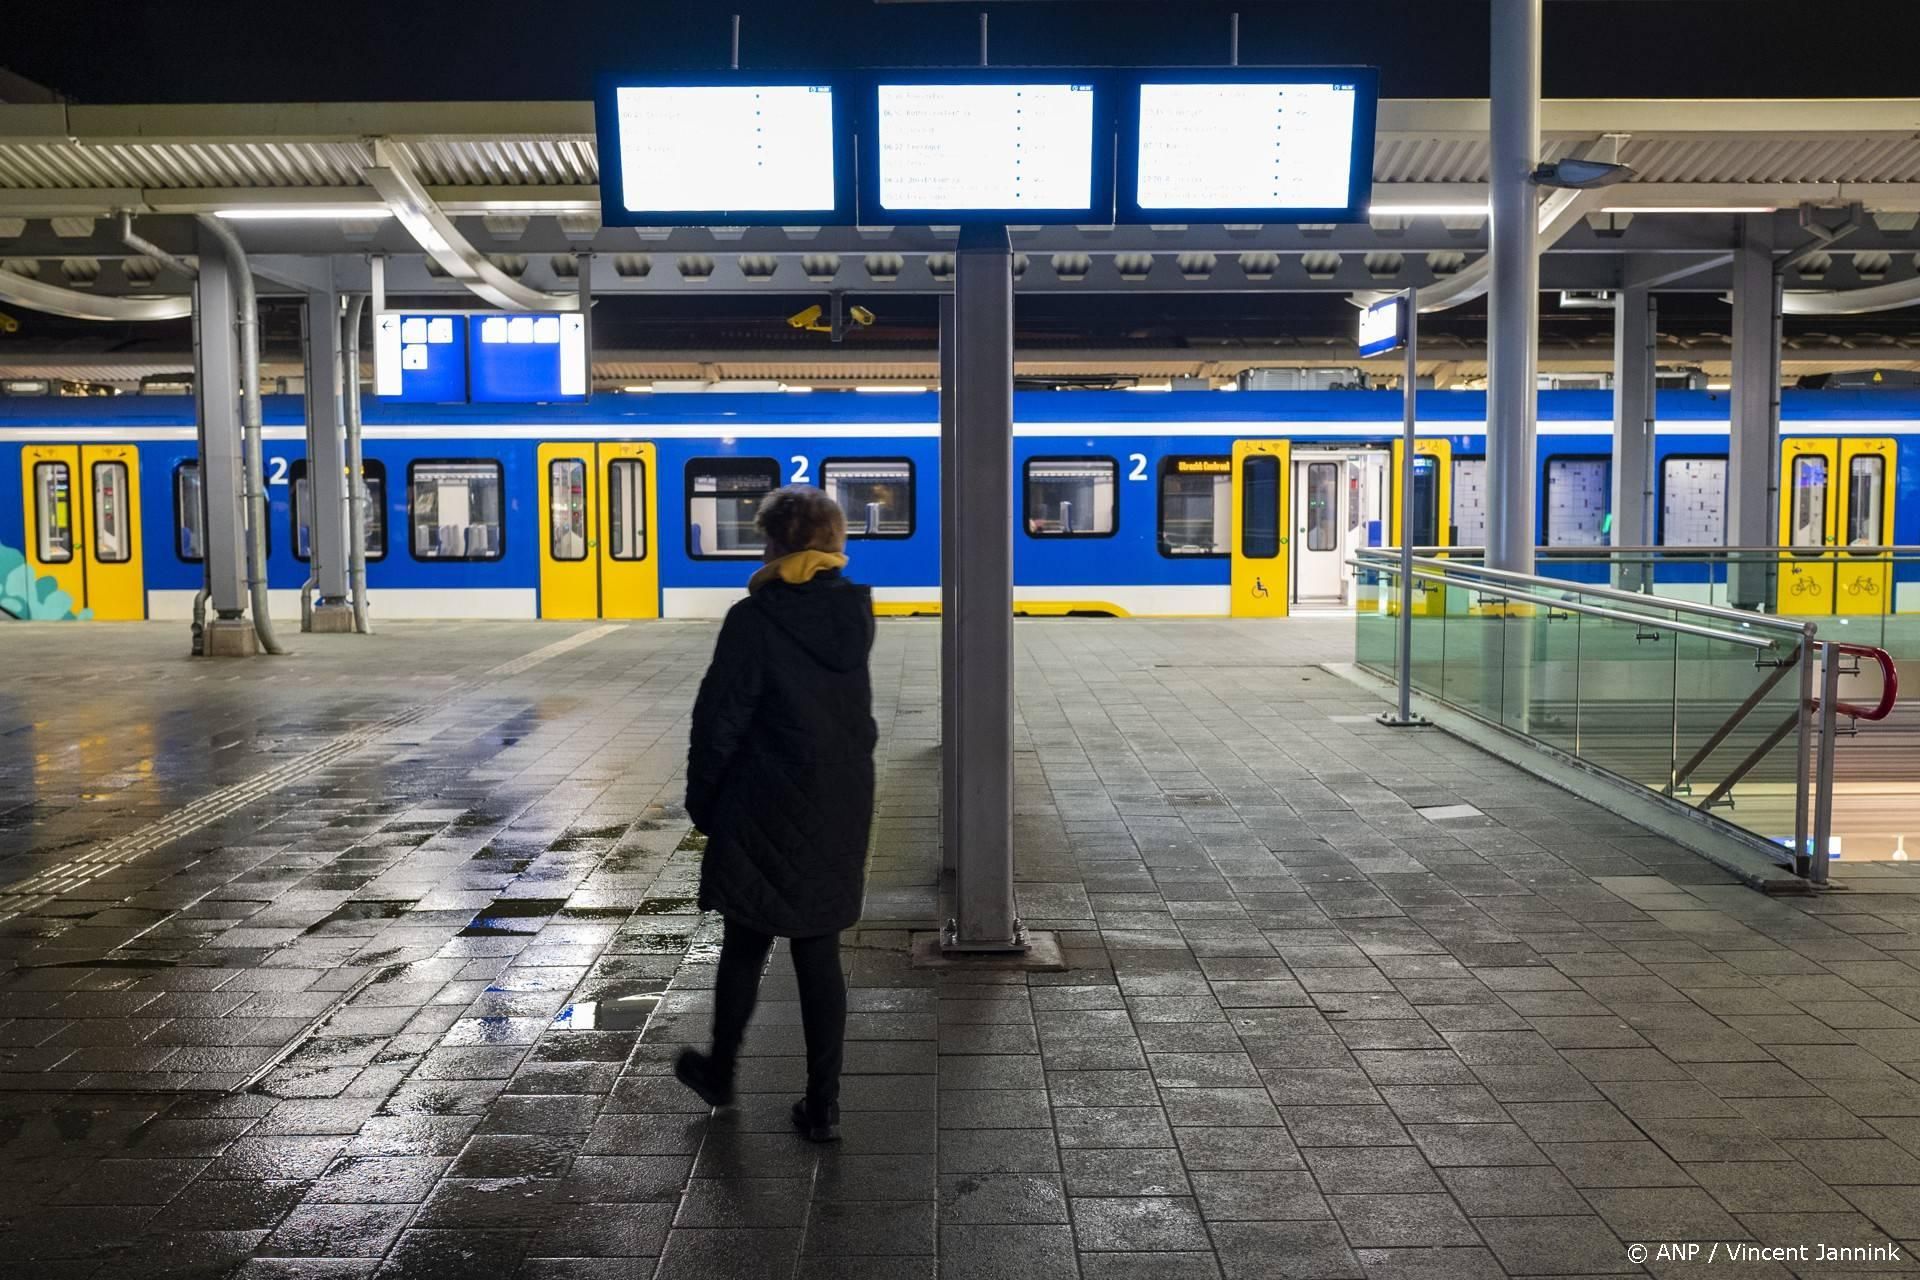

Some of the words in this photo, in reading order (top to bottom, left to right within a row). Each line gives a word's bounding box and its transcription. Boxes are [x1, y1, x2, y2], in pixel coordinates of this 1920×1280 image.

[269, 456, 289, 485] 2
[790, 455, 810, 483] 2
[1128, 453, 1148, 481] 2
